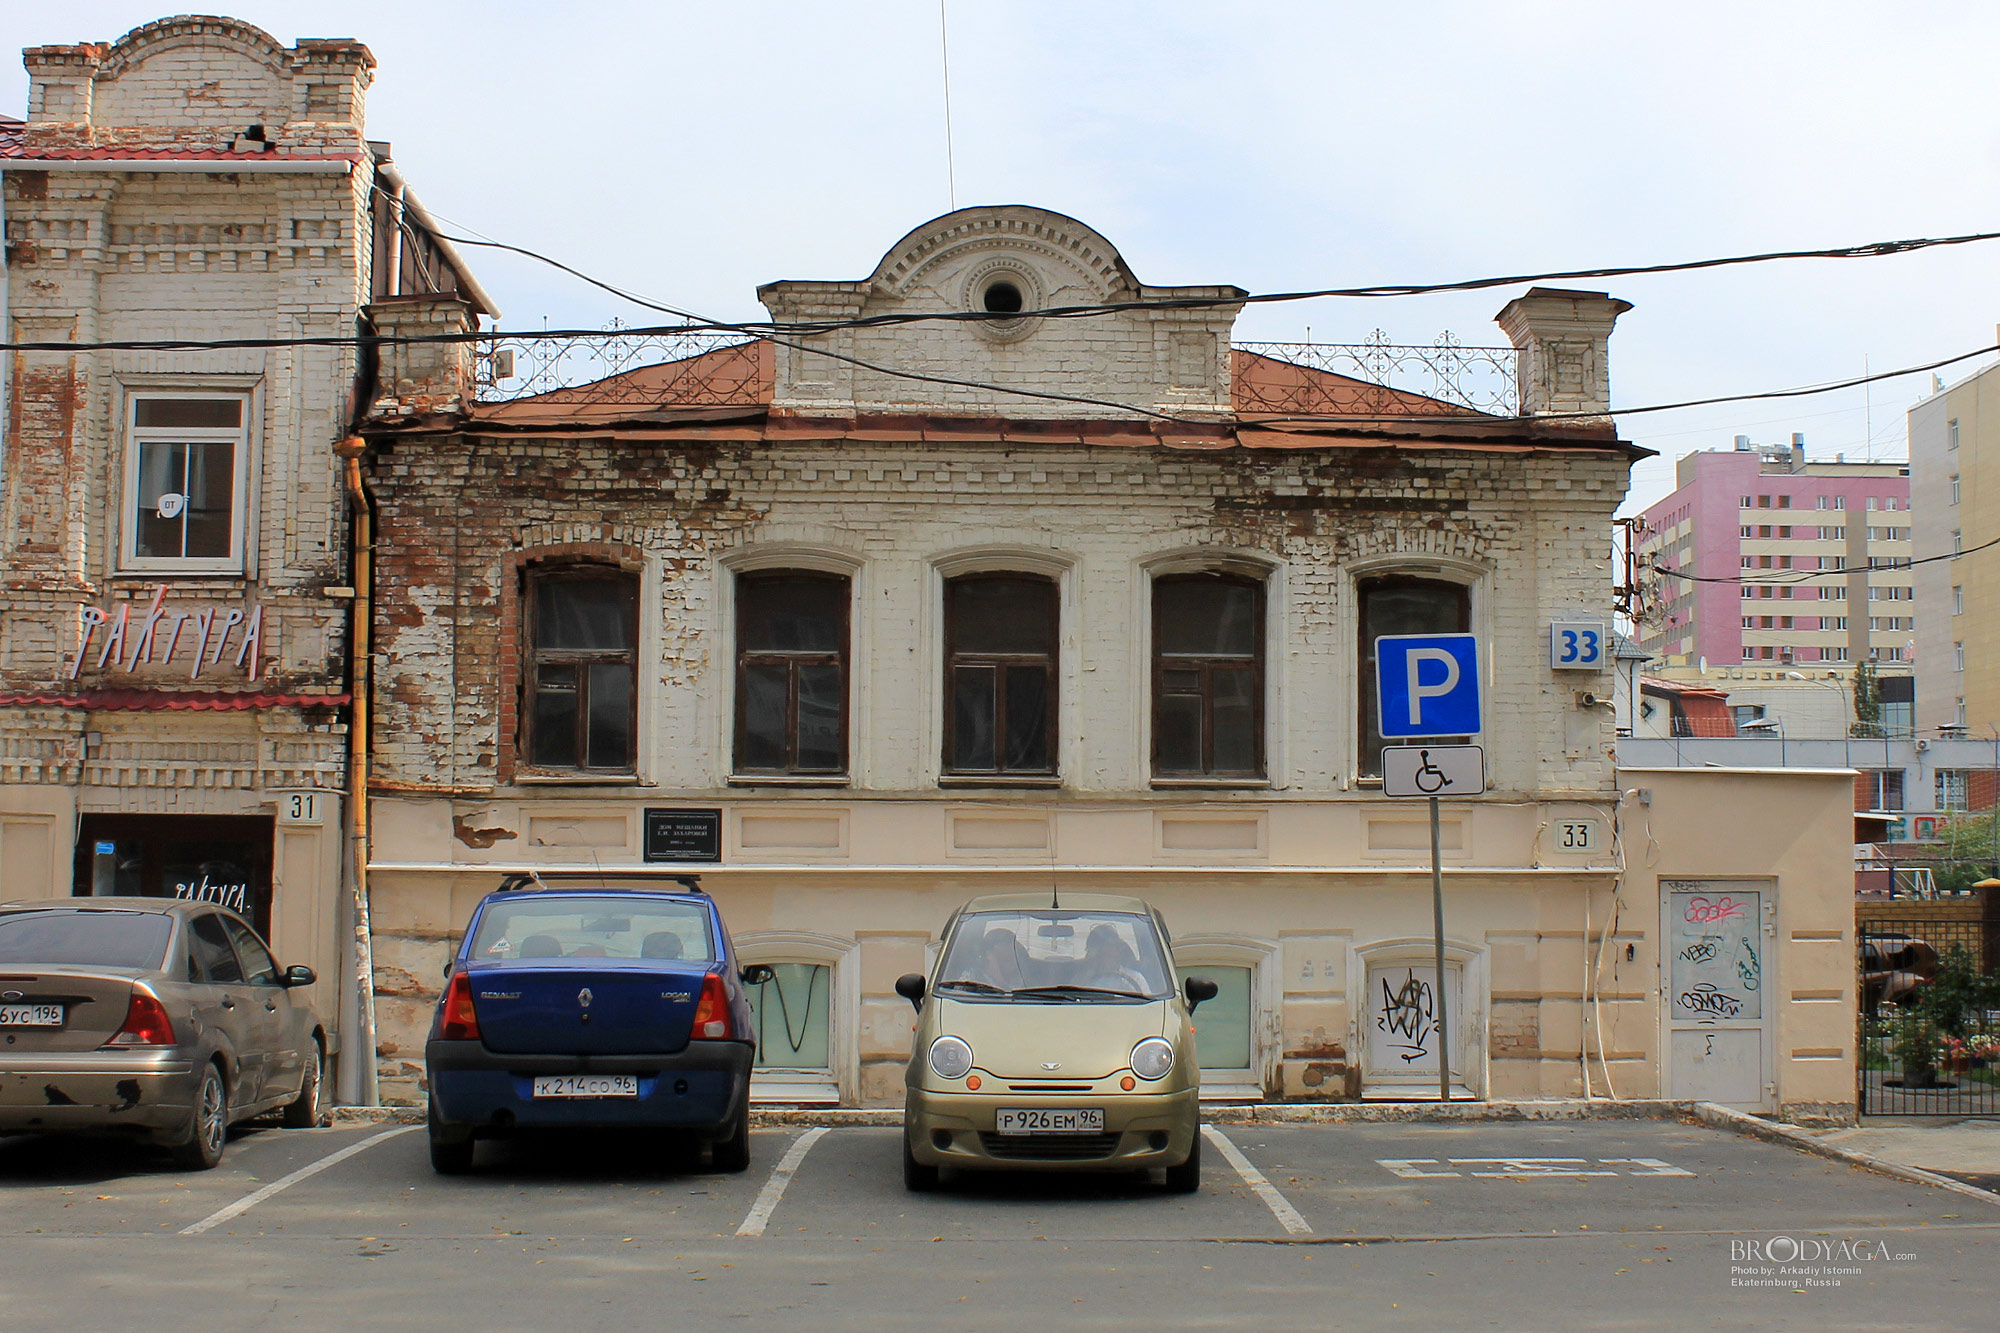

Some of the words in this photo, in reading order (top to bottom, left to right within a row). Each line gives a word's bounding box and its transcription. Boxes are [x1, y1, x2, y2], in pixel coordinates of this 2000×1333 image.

[1560, 630, 1599, 663] 33
[1406, 648, 1460, 725] P
[291, 794, 313, 819] 31
[1563, 824, 1587, 847] 33
[614, 1076, 631, 1090] 96
[1080, 1110, 1098, 1124] 96
